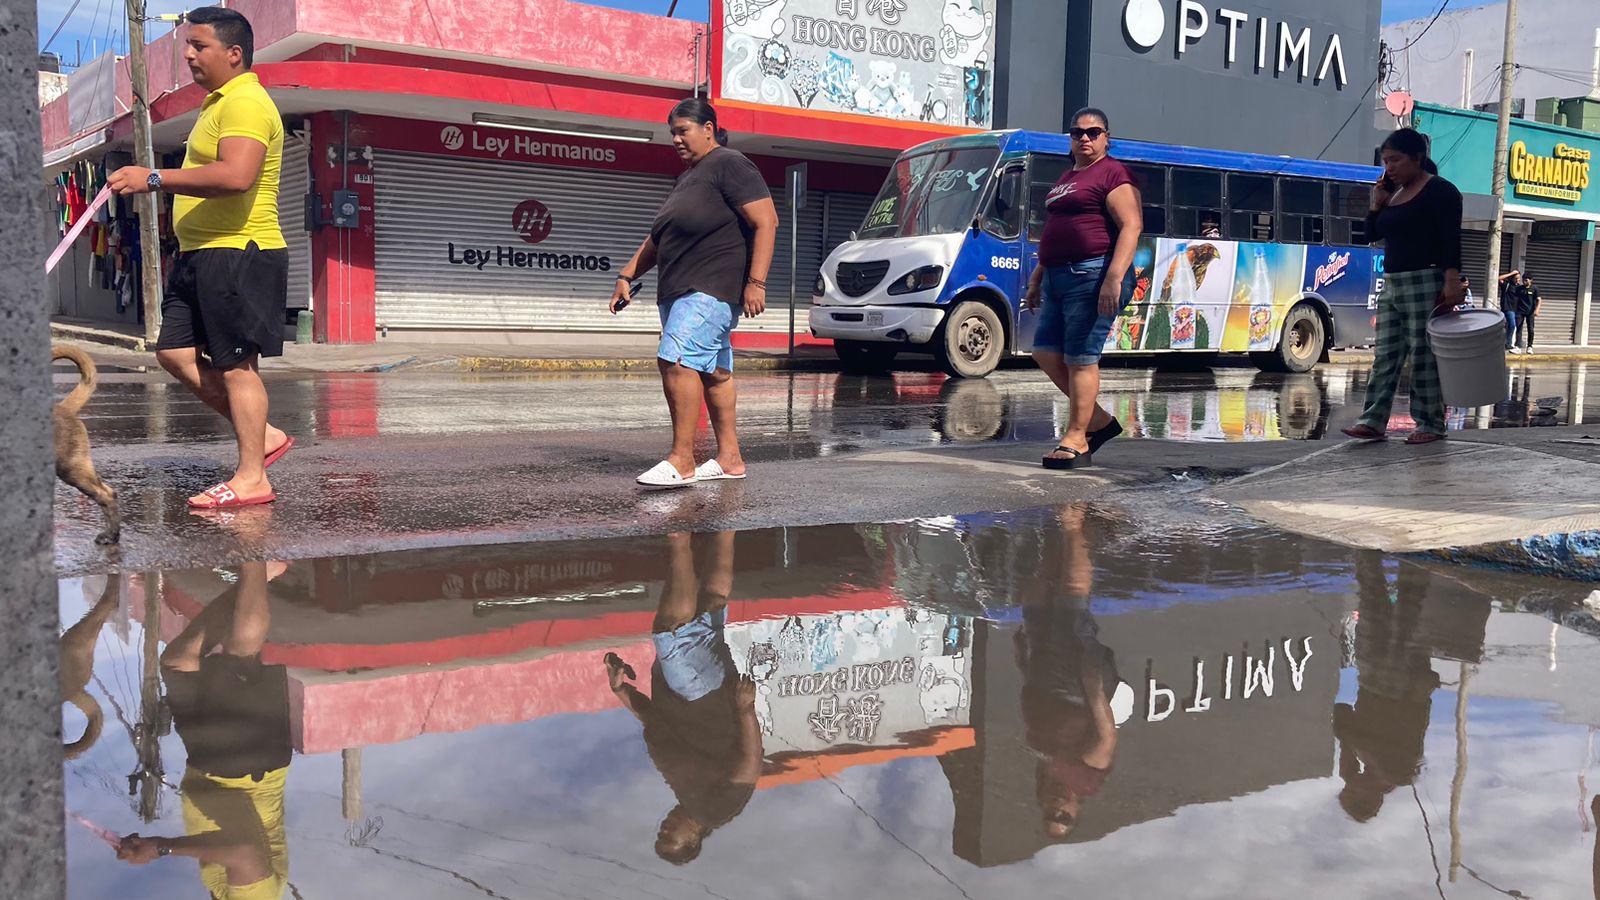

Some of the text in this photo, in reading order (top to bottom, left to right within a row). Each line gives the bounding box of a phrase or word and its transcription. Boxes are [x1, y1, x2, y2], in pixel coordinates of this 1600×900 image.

[792, 15, 936, 62] HONG KONG
[472, 130, 616, 162] Ley Hermanos
[1555, 143, 1591, 160] Casa
[1510, 140, 1590, 188] GRANADOS
[1521, 184, 1538, 194] ROPA
[1543, 187, 1579, 199] UNIFORMES
[448, 242, 611, 271] Ley Hermanos
[991, 256, 1020, 270] 8665
